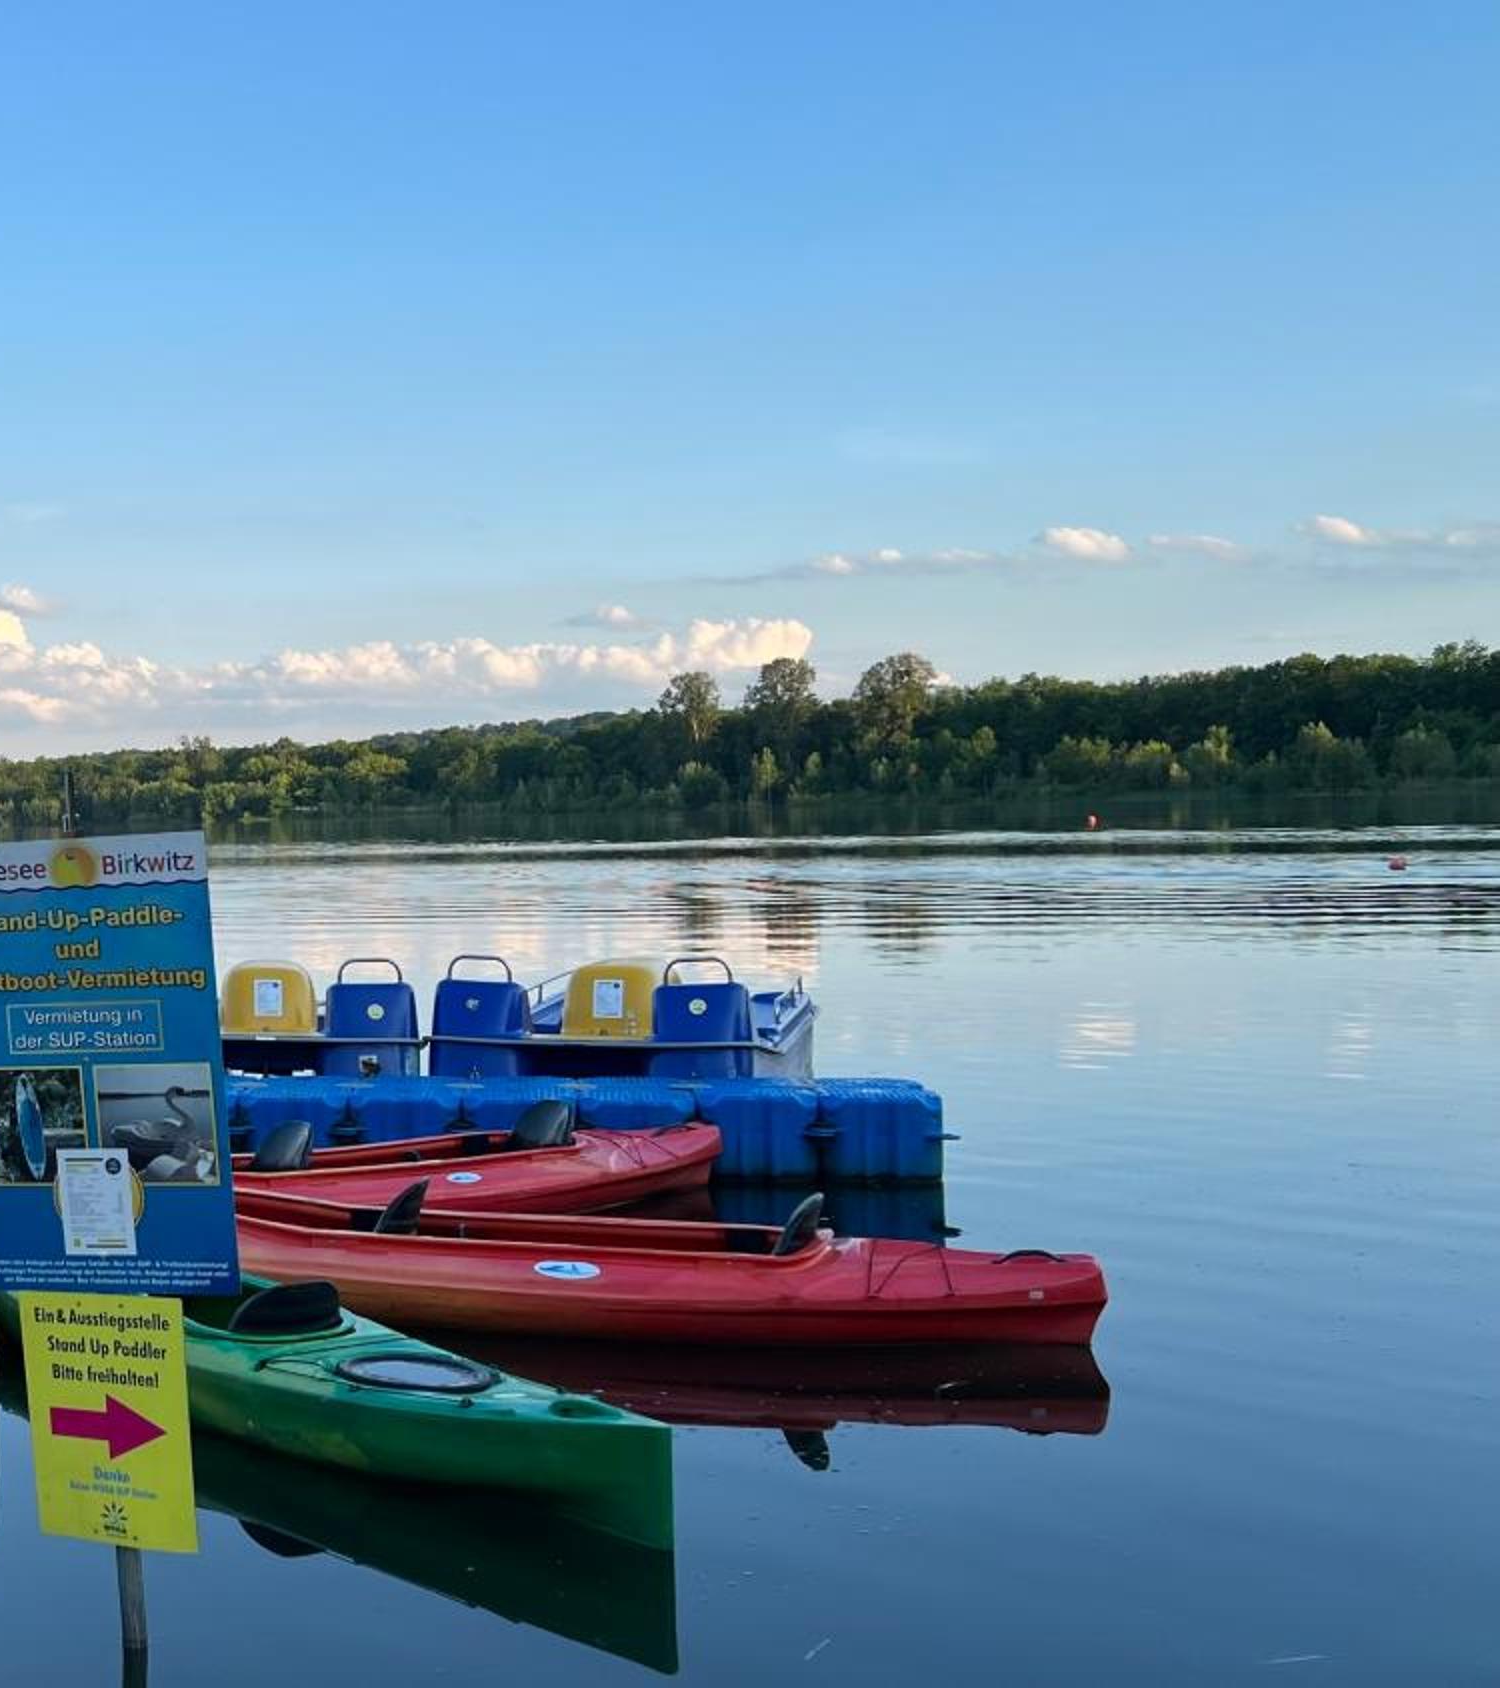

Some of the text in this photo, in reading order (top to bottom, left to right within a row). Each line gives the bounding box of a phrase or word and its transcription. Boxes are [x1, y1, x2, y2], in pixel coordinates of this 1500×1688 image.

[102, 851, 195, 875] Birkwitz
[55, 939, 100, 959] und
[24, 1008, 143, 1027] Vermietung in
[15, 1031, 157, 1049] der SUP-Station
[69, 1309, 170, 1332] Ausstiegsstelle
[47, 1336, 167, 1359] Stand Up Paddler
[52, 1364, 159, 1388] Bitte freihalten!
